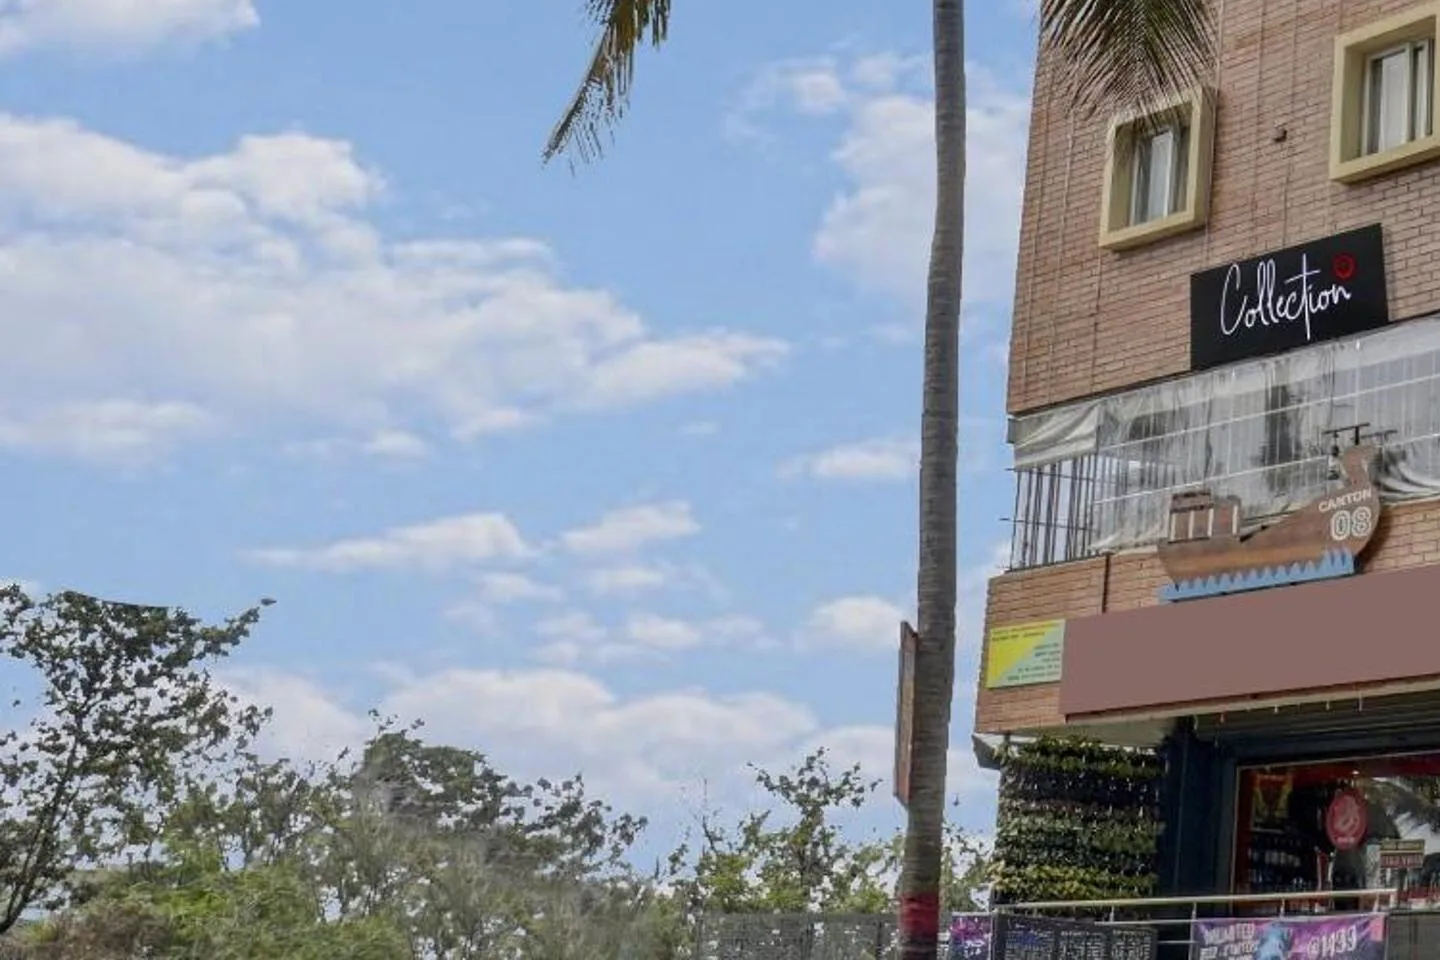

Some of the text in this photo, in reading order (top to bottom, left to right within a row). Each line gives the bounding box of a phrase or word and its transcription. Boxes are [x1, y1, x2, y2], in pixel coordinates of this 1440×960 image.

[1221, 253, 1351, 340] Collection
[1319, 486, 1371, 513] CANTON
[1330, 506, 1372, 540] 08
